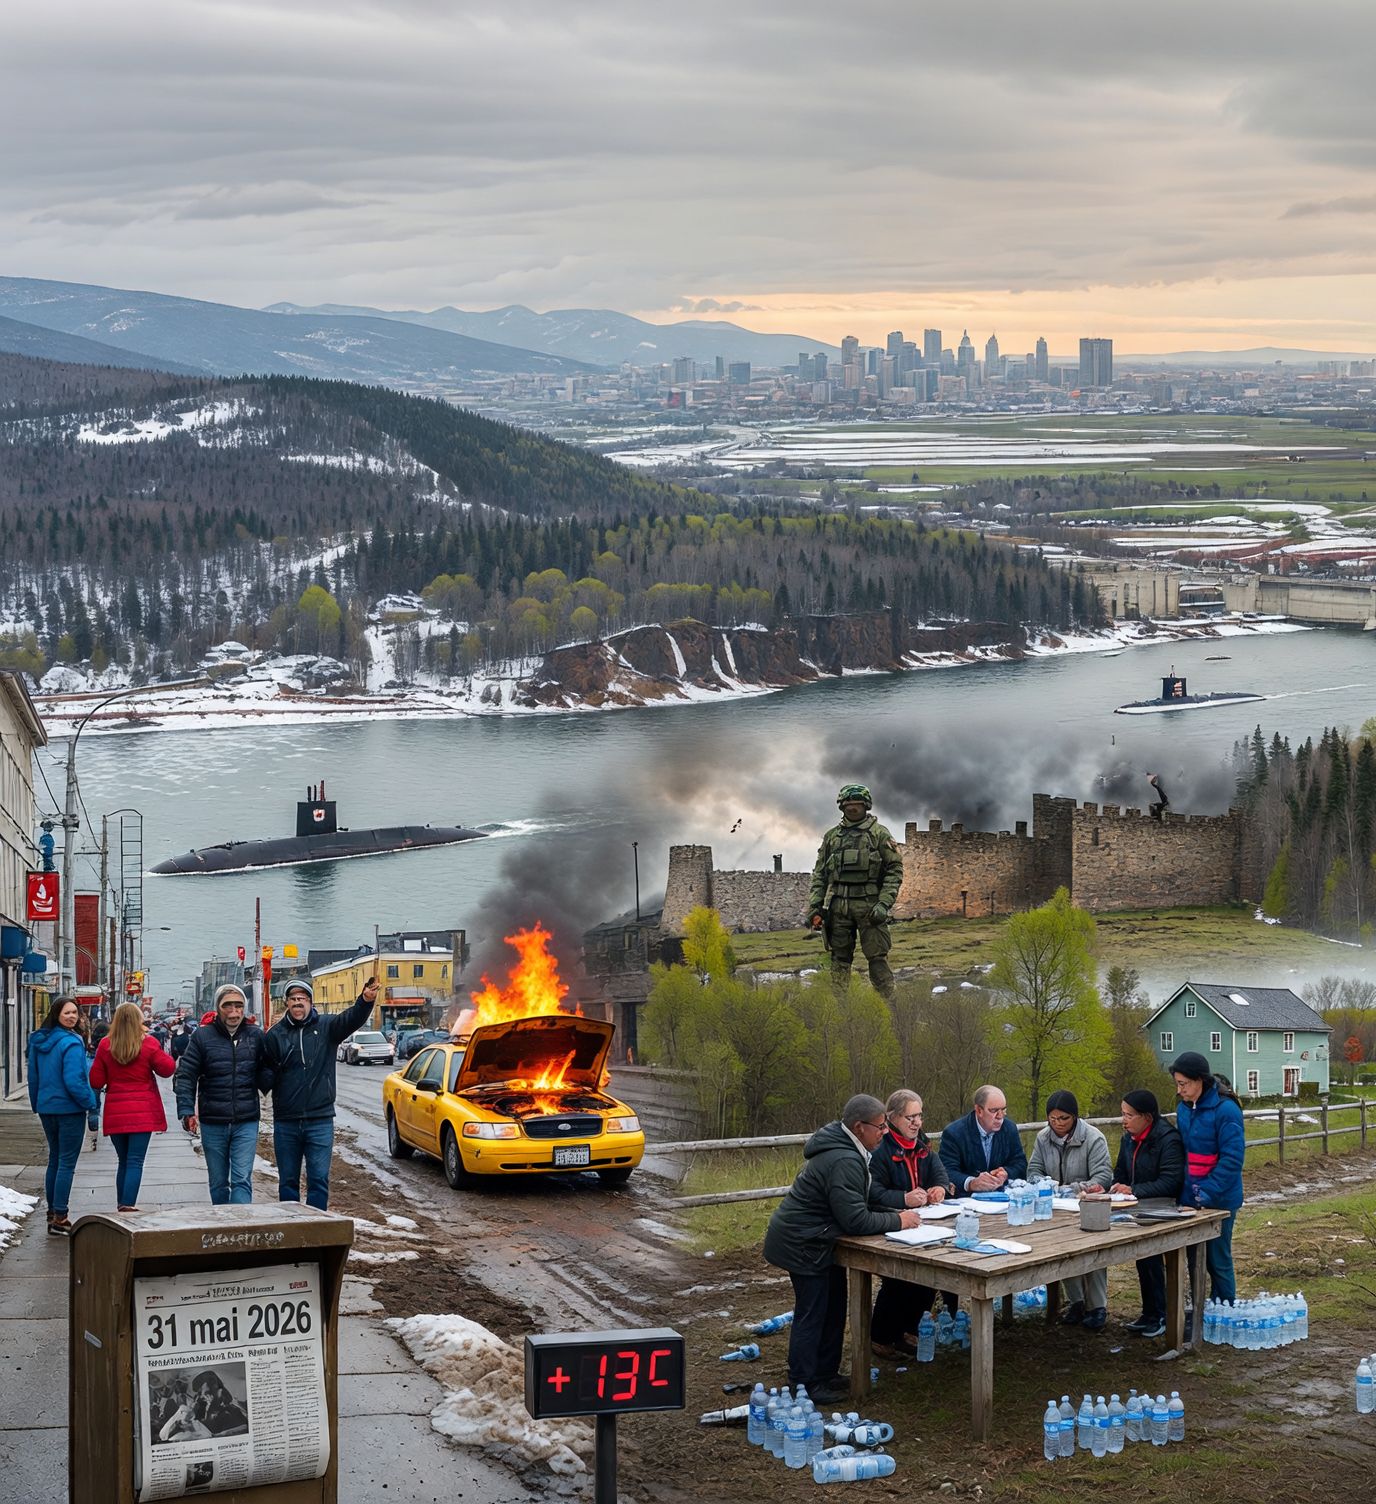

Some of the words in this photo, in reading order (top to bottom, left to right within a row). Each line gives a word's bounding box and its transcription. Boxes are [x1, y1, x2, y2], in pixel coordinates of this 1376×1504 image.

[147, 1313, 178, 1349] 31
[189, 1307, 239, 1346] mai
[247, 1300, 312, 1339] 2026
